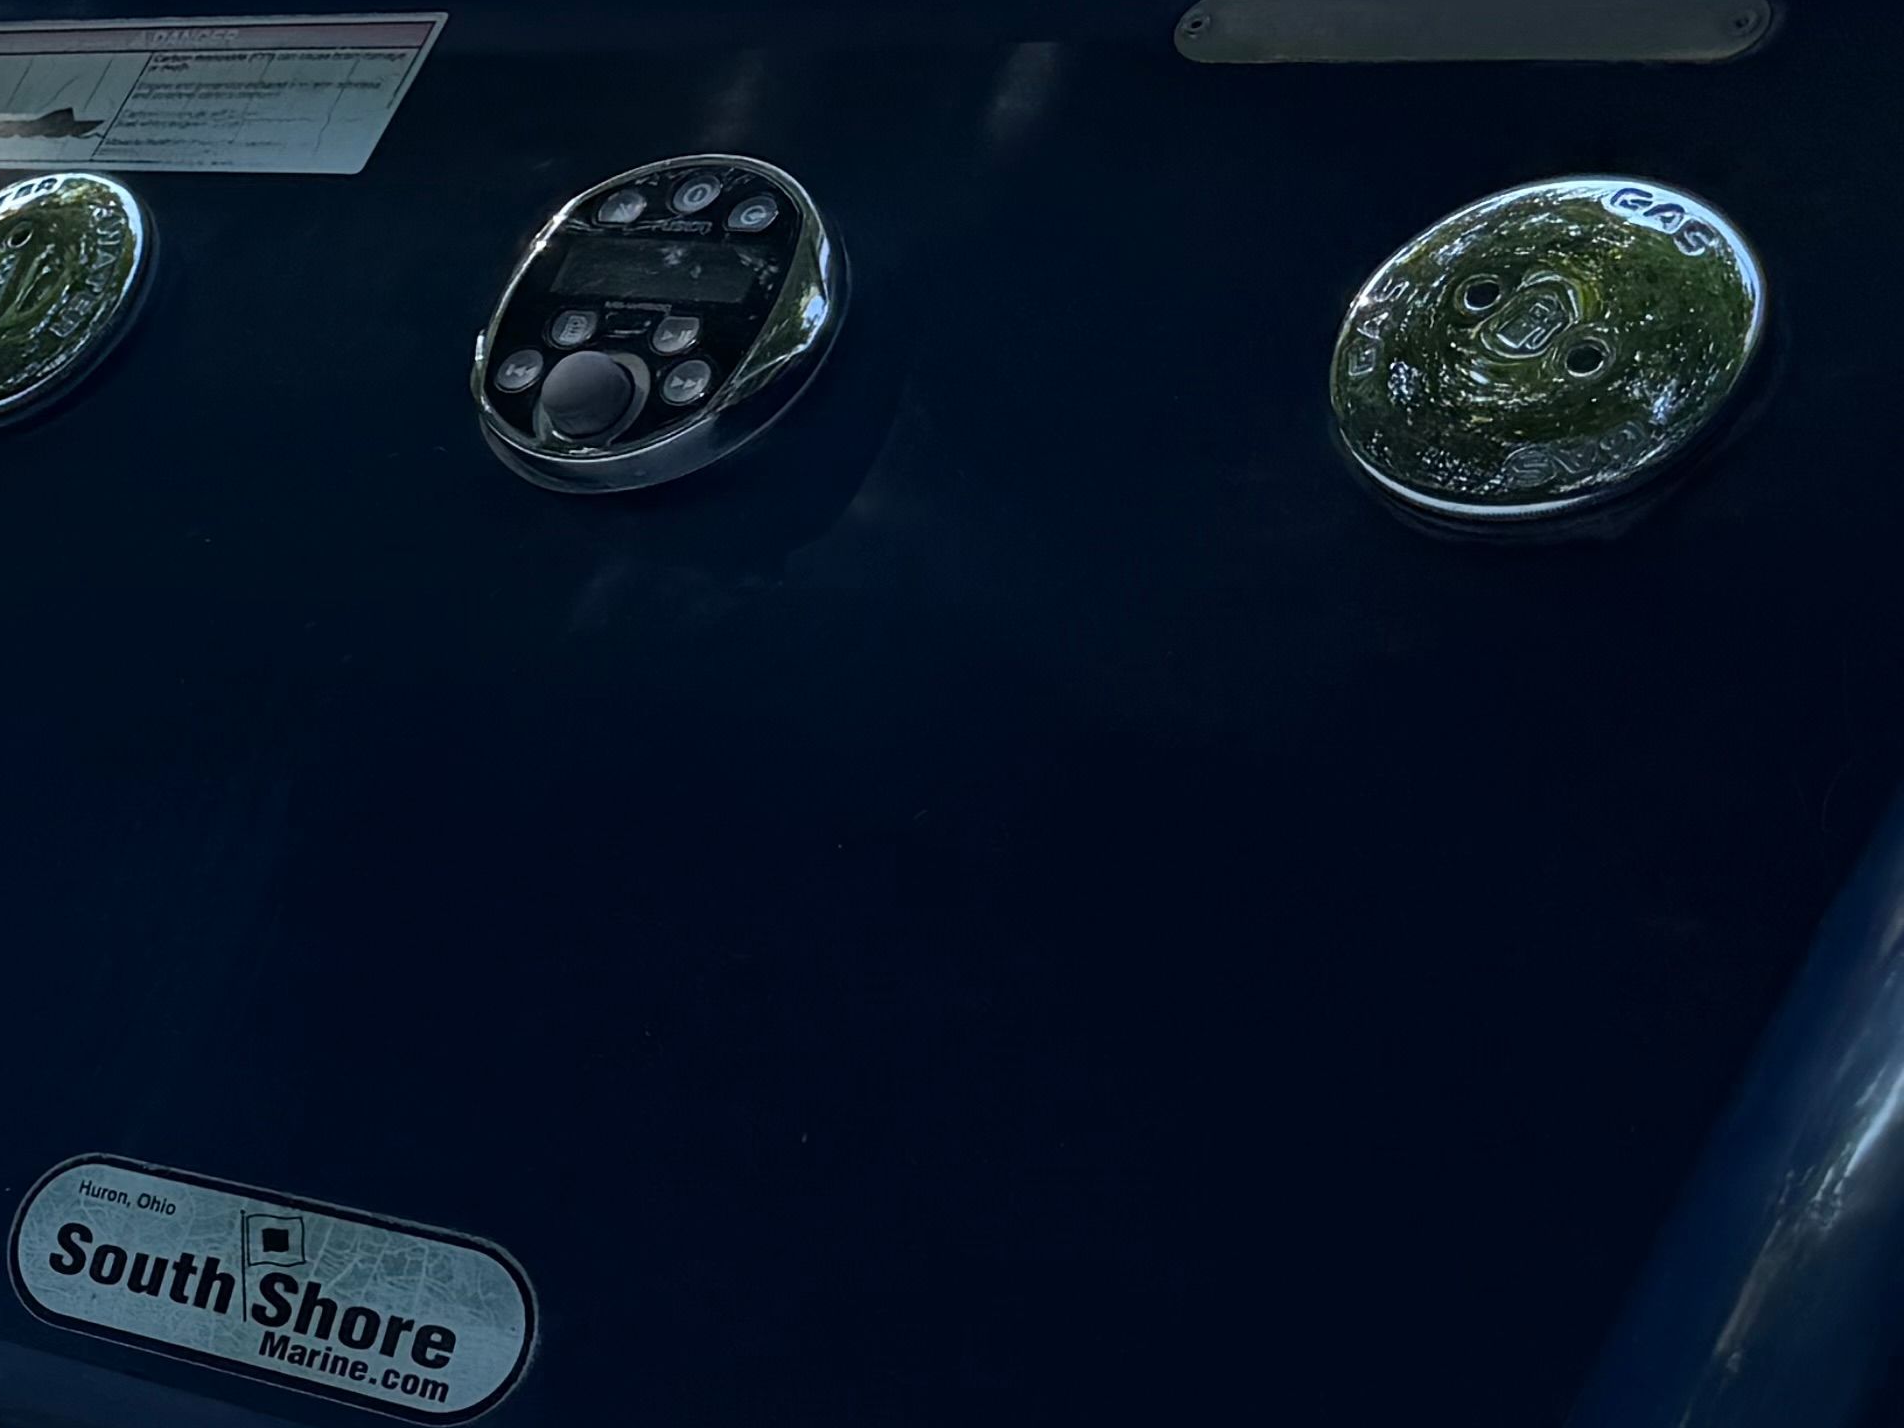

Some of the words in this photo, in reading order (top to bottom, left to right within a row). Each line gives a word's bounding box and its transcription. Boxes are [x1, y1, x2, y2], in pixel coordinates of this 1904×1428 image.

[1608, 186, 1717, 256] GAS
[77, 1178, 132, 1210] Huron,
[136, 1191, 177, 1217] Ohio
[48, 1221, 237, 1315] South
[250, 1272, 457, 1370] Shore
[258, 1329, 450, 1403] Marine.com
